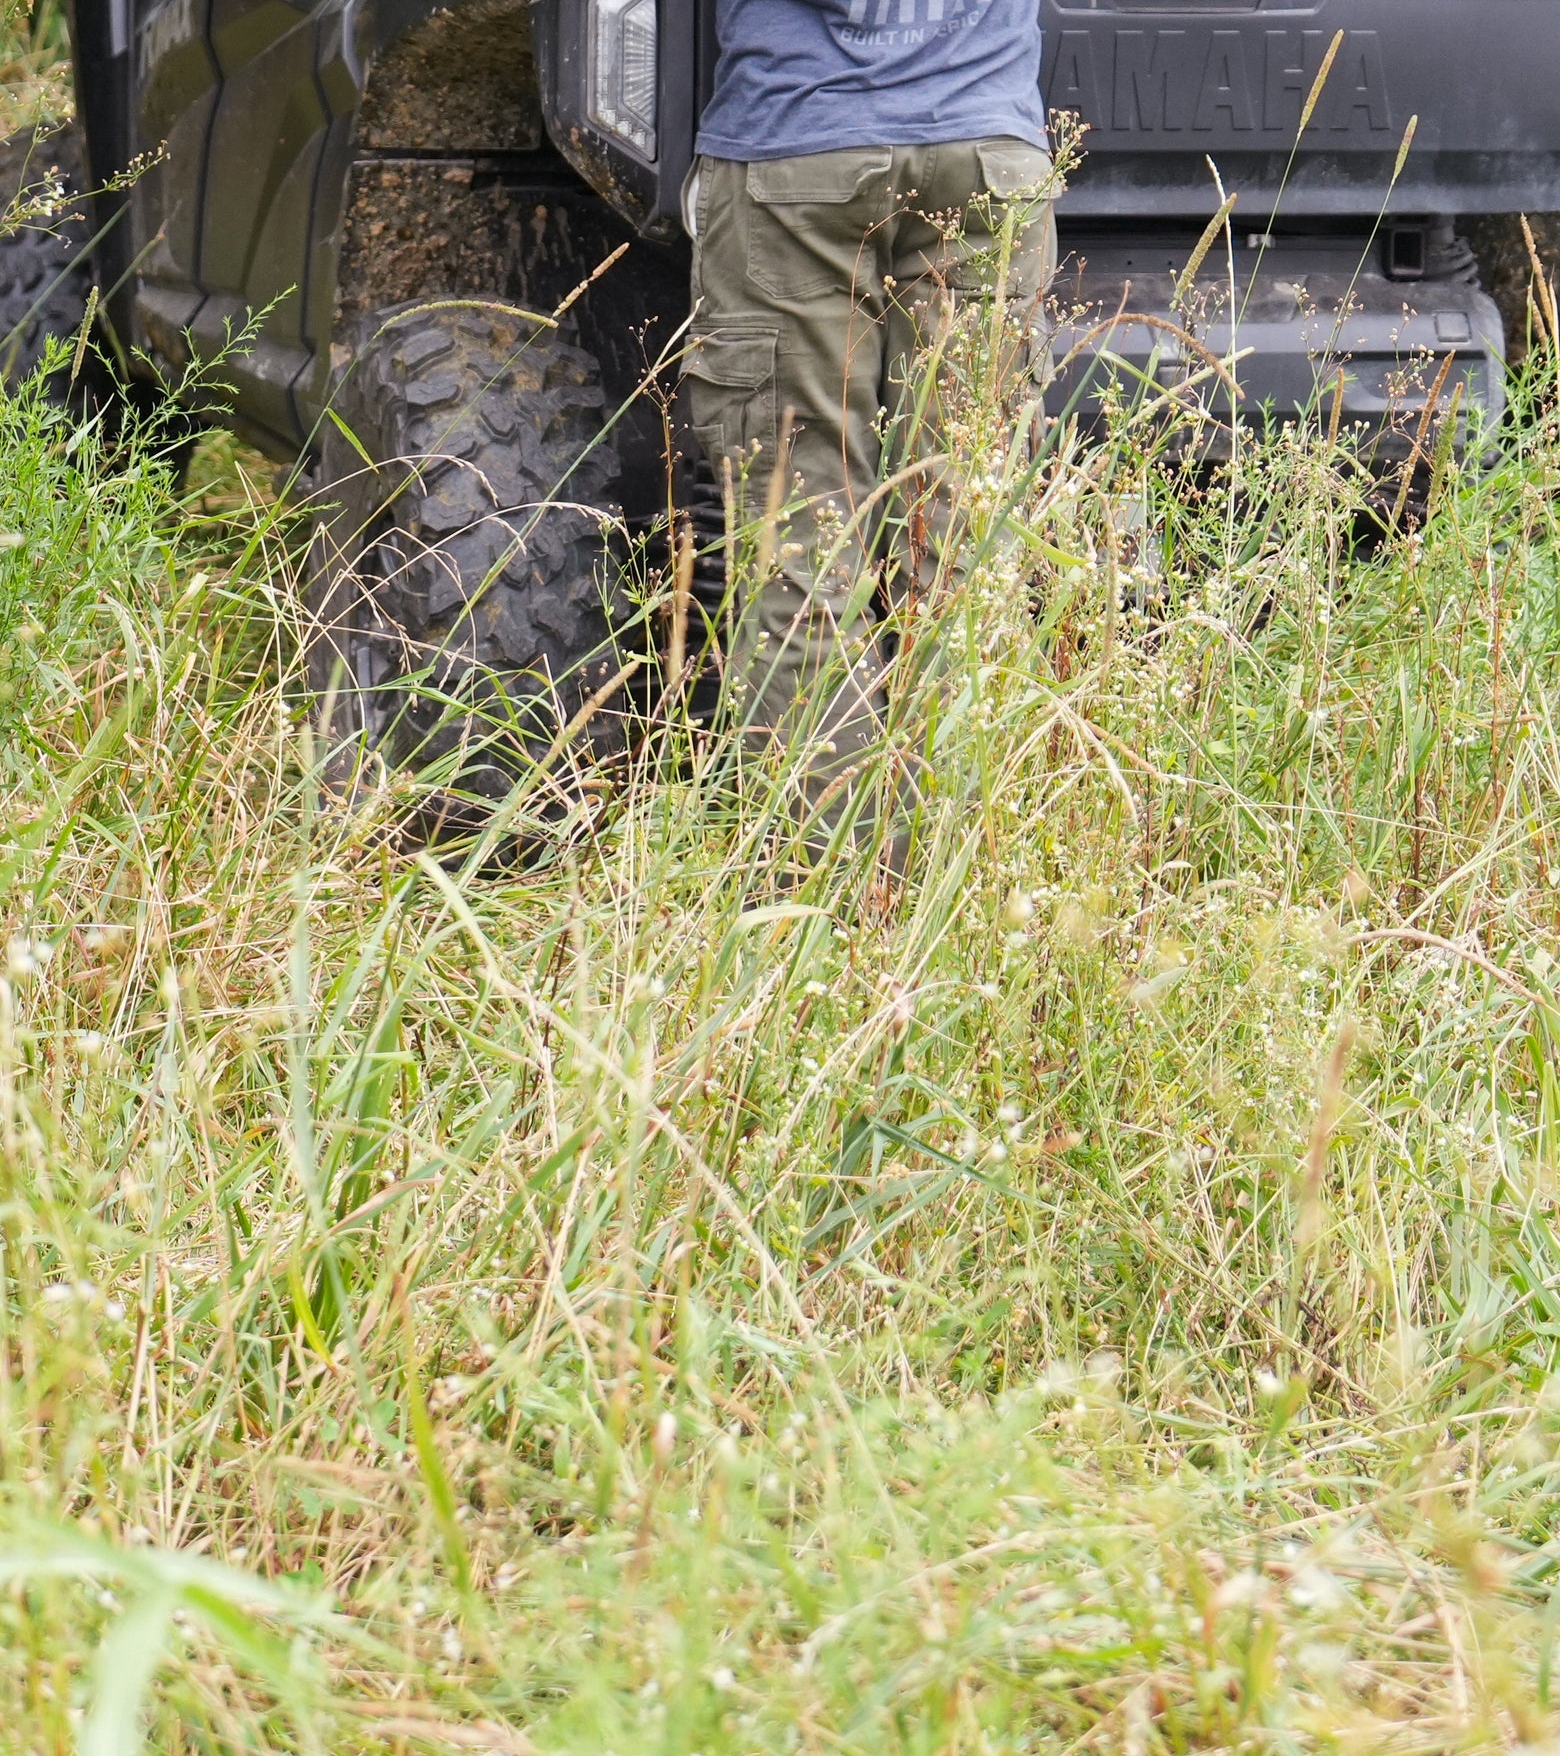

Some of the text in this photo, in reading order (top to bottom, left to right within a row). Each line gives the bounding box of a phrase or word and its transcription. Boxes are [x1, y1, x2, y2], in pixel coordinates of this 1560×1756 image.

[840, 26, 898, 45] BUILT
[903, 27, 925, 45] IN
[1040, 29, 1391, 131] AMAHA
